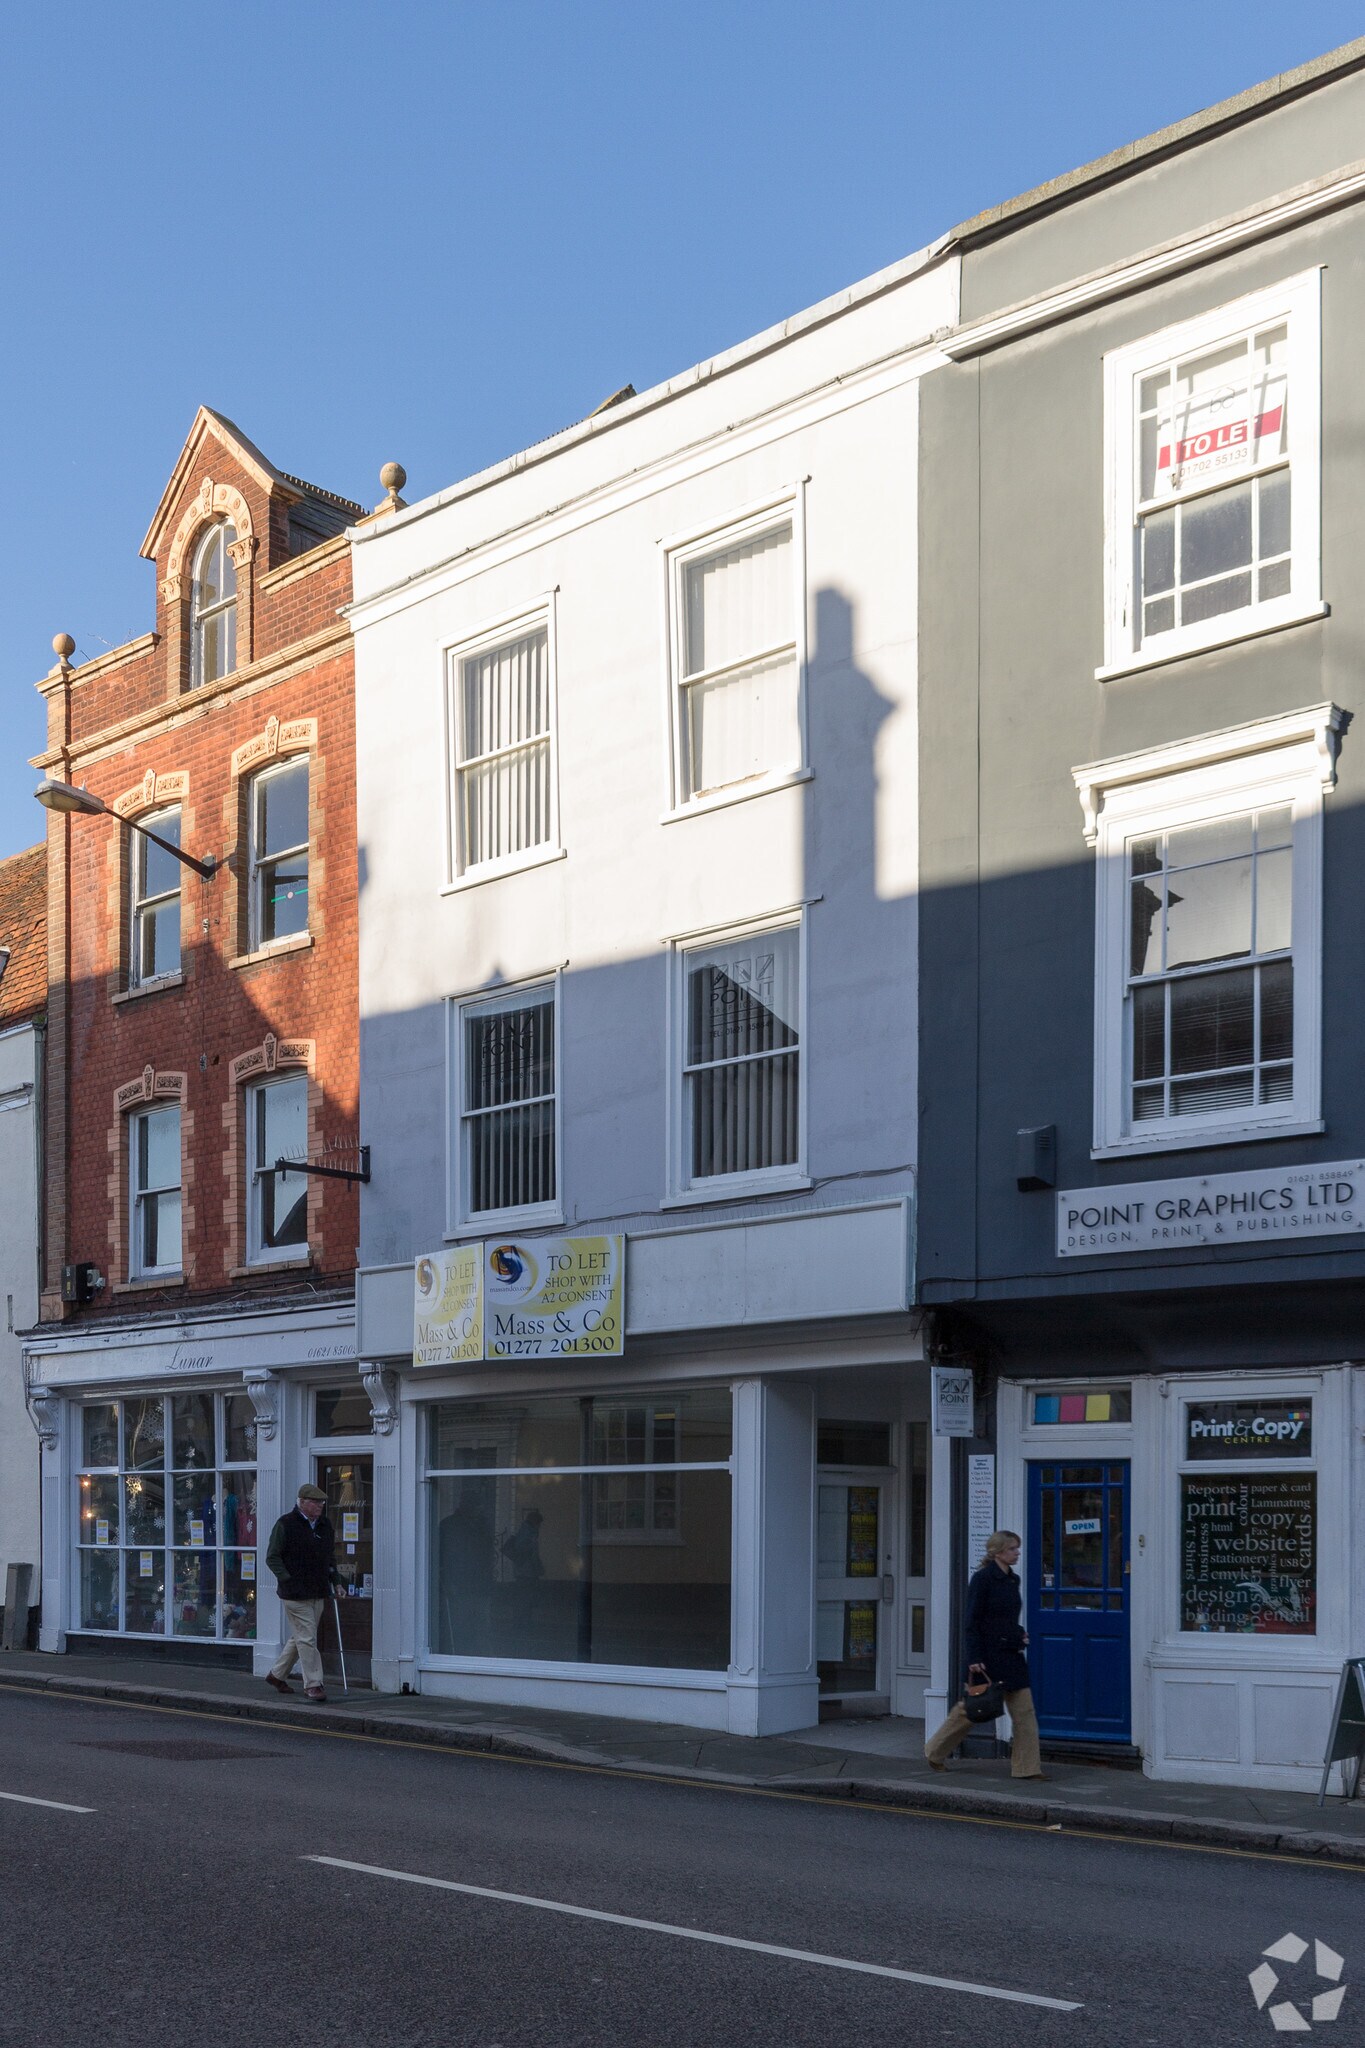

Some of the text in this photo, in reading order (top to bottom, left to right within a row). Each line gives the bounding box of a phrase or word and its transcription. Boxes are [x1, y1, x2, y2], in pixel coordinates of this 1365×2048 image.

[1184, 434, 1211, 459] TO
[1180, 460, 1211, 477] 01702
[710, 980, 774, 1008] POINT
[1287, 1174, 1315, 1183] 01621
[1067, 1182, 1354, 1230] POINT GRAPHICS LTD
[1067, 1210, 1354, 1247] DESIGN, PRINT & PUBLISHING
[547, 1252, 610, 1271] TO LET
[445, 1261, 476, 1281] TO LET
[545, 1274, 611, 1288] SHOP WITH
[443, 1282, 477, 1298] SHOP WITH
[541, 1289, 615, 1304] A2 CONSENT
[449, 1297, 479, 1312] CONSENT
[418, 1316, 479, 1345] Mass & Co
[494, 1309, 615, 1336] Mass & Co
[307, 1346, 331, 1358] 01621
[418, 1342, 479, 1362] 01277 201300
[494, 1336, 615, 1355] 01277 201300
[165, 1343, 213, 1370] Lunar
[941, 1394, 970, 1403] POINT
[1224, 1435, 1270, 1444] CENTRE
[1187, 1484, 1237, 1497] Reports
[1250, 1482, 1312, 1495] paper & card
[1186, 1499, 1237, 1522] print
[1236, 1483, 1248, 1526] colour
[1251, 1498, 1311, 1510] Laminating
[1071, 1522, 1095, 1530] OPEN
[1210, 1522, 1233, 1531] html
[1250, 1513, 1296, 1530] copy
[1251, 1527, 1269, 1535] Fax
[1213, 1533, 1297, 1551] website
[1295, 1514, 1312, 1569] cards
[1186, 1526, 1196, 1580] T Shirts
[1197, 1522, 1209, 1582] business
[1210, 1553, 1269, 1567] stationery
[1280, 1558, 1299, 1567] USB
[1210, 1567, 1250, 1584] cmyk
[1269, 1553, 1278, 1593] graphics
[1280, 1574, 1311, 1589] flyer
[1185, 1584, 1248, 1608] design
[1186, 1607, 1247, 1627] bnding
